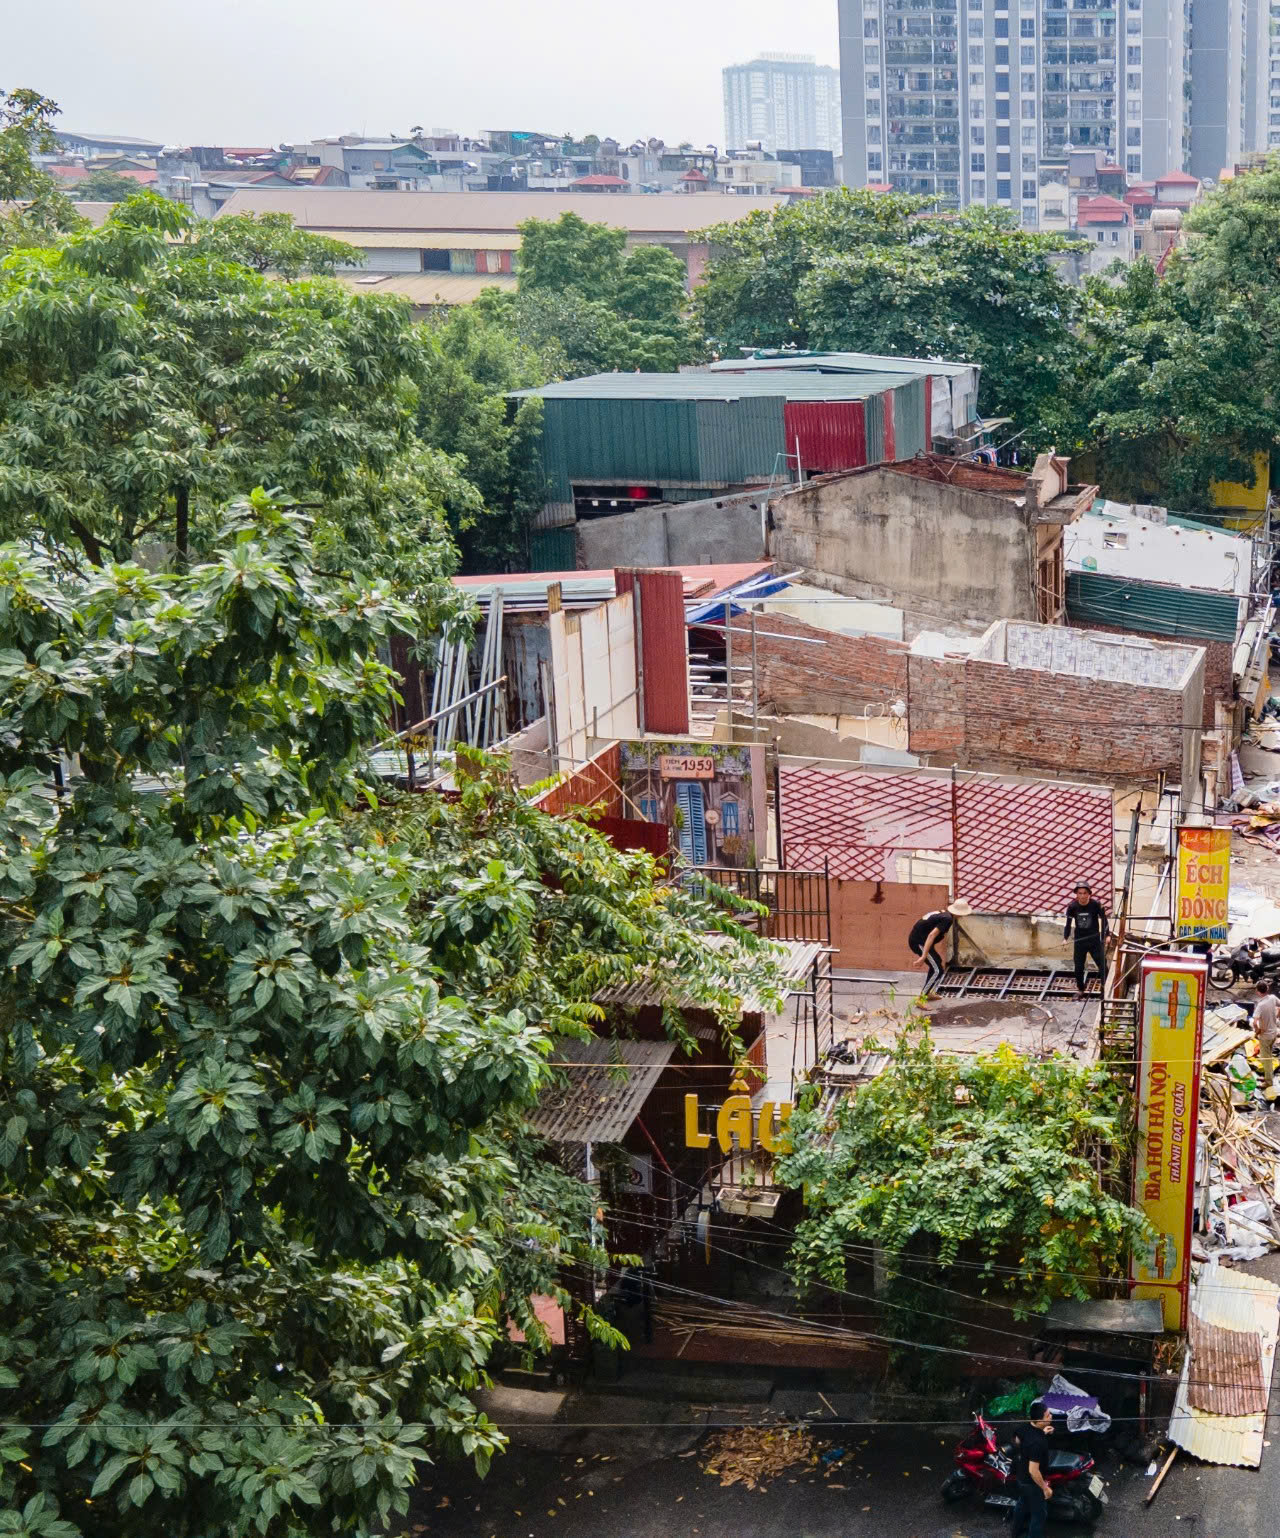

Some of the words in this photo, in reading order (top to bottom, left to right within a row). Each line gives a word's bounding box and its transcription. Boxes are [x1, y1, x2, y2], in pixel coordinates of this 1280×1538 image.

[681, 760, 712, 771] 1959
[1186, 855, 1224, 885] ẾCH
[1181, 887, 1226, 920] ĐỒNG
[1148, 1062, 1171, 1097] NỘI
[1145, 1168, 1161, 1201] BIA
